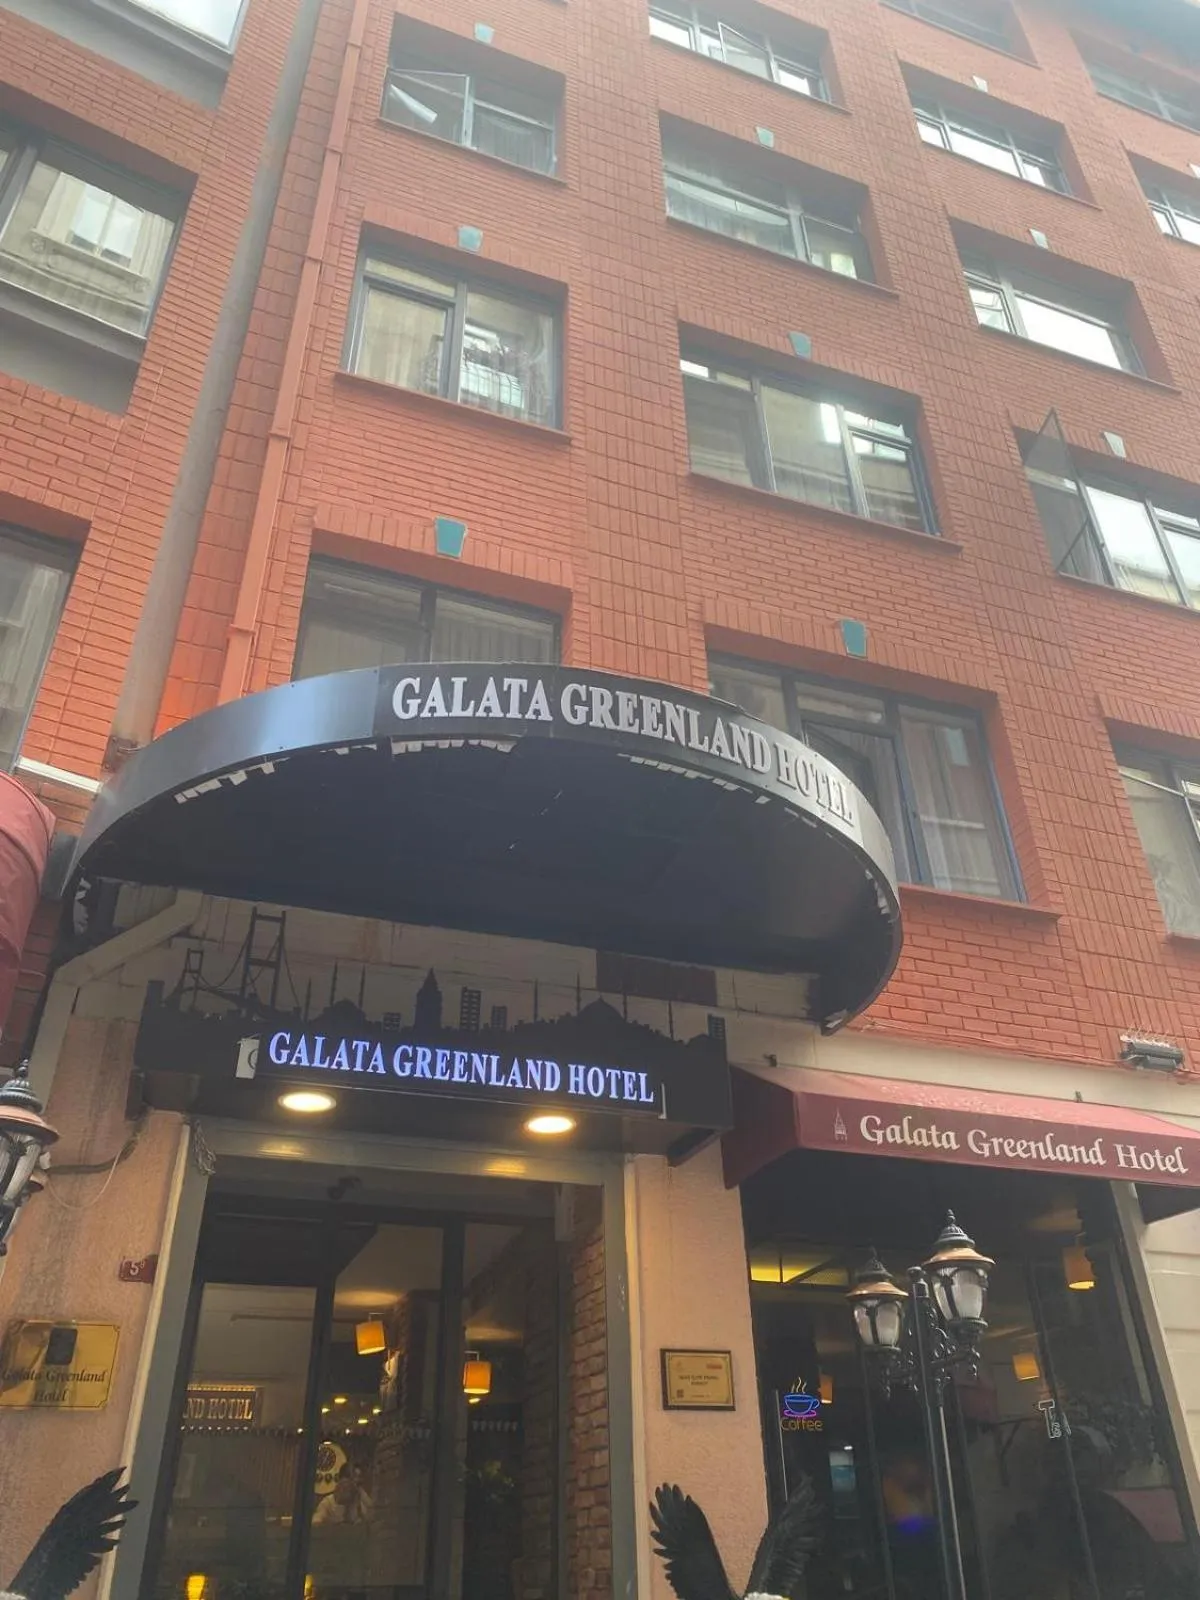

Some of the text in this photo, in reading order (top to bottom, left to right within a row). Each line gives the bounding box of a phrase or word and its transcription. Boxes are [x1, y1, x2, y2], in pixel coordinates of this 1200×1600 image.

[392, 676, 855, 828] GALATA GREENLAND HOTEL
[268, 1031, 654, 1103] GALATA GREENLAND HOTEL
[860, 1114, 1189, 1175] Galata Greenland Hotel
[207, 1398, 253, 1420] HOTEL
[780, 1416, 823, 1431] Coffee
